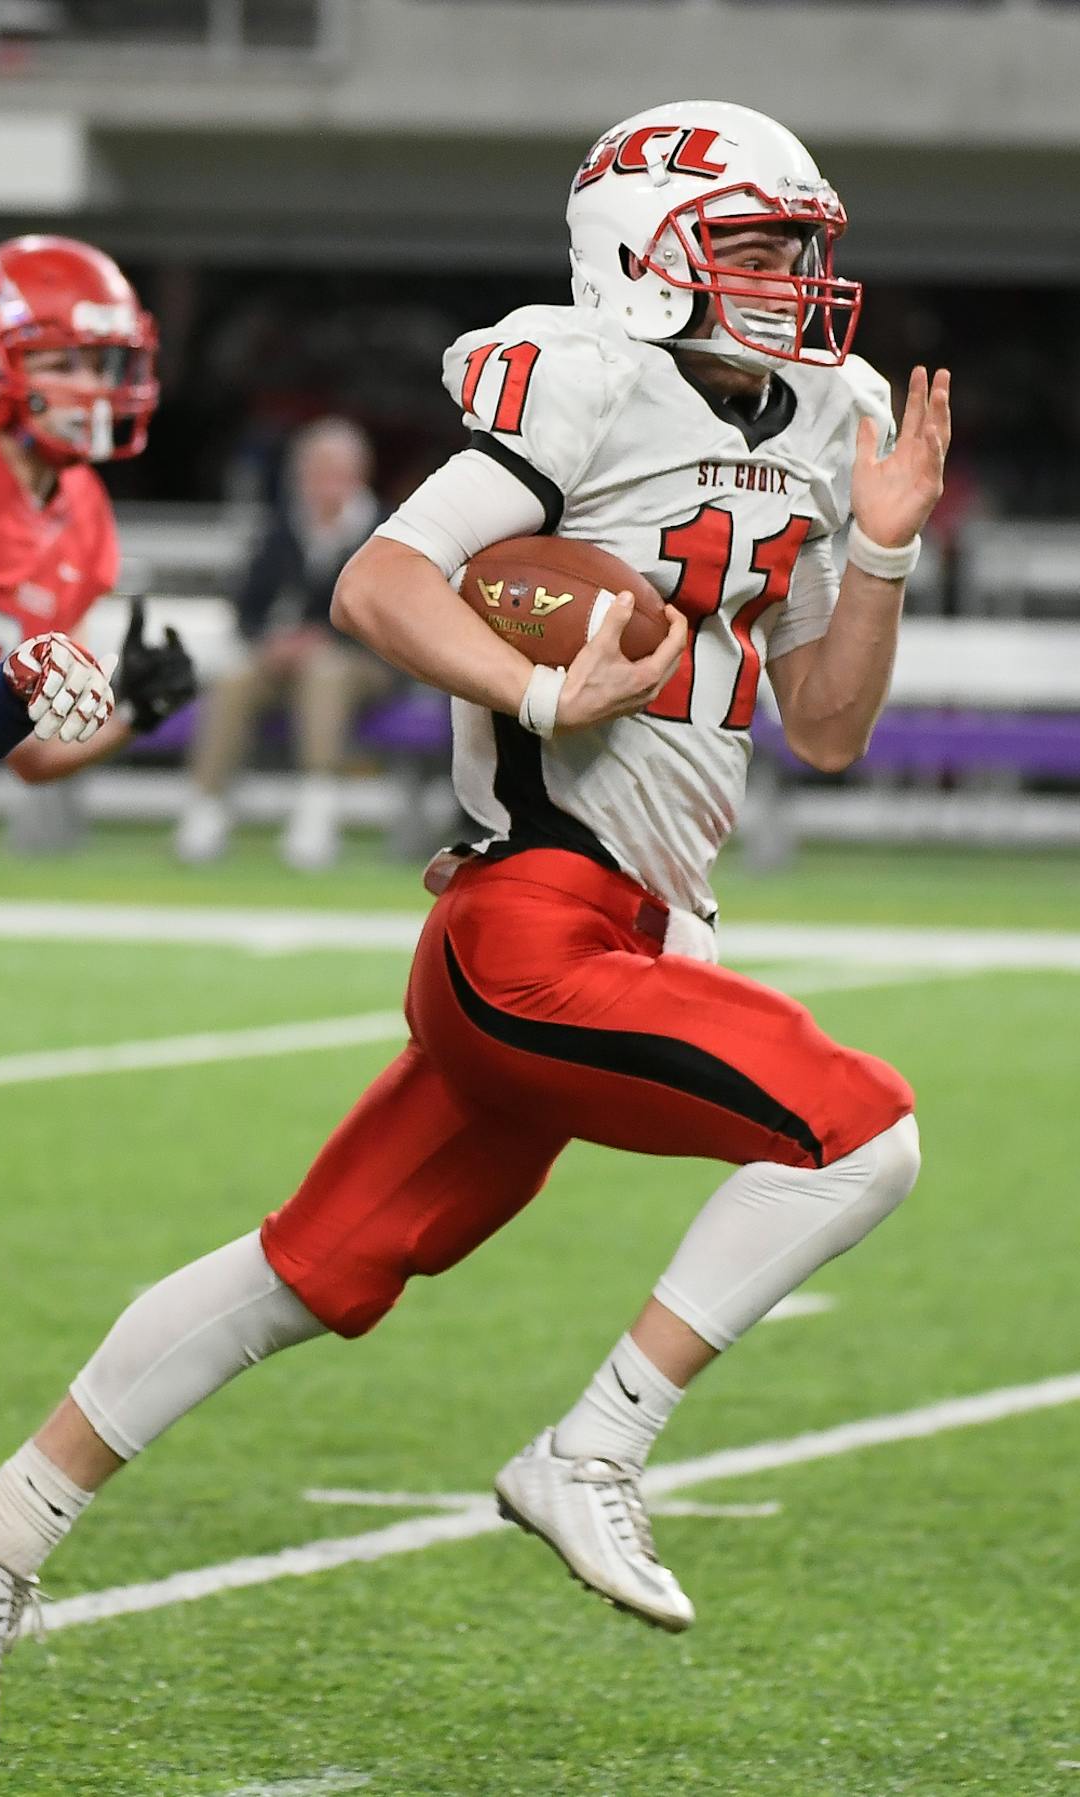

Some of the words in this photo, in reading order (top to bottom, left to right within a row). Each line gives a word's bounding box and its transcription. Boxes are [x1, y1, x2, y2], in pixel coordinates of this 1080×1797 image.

[462, 341, 541, 437] 11
[698, 461, 724, 487] ST.
[734, 463, 788, 495] CROIX
[643, 503, 813, 731] 11
